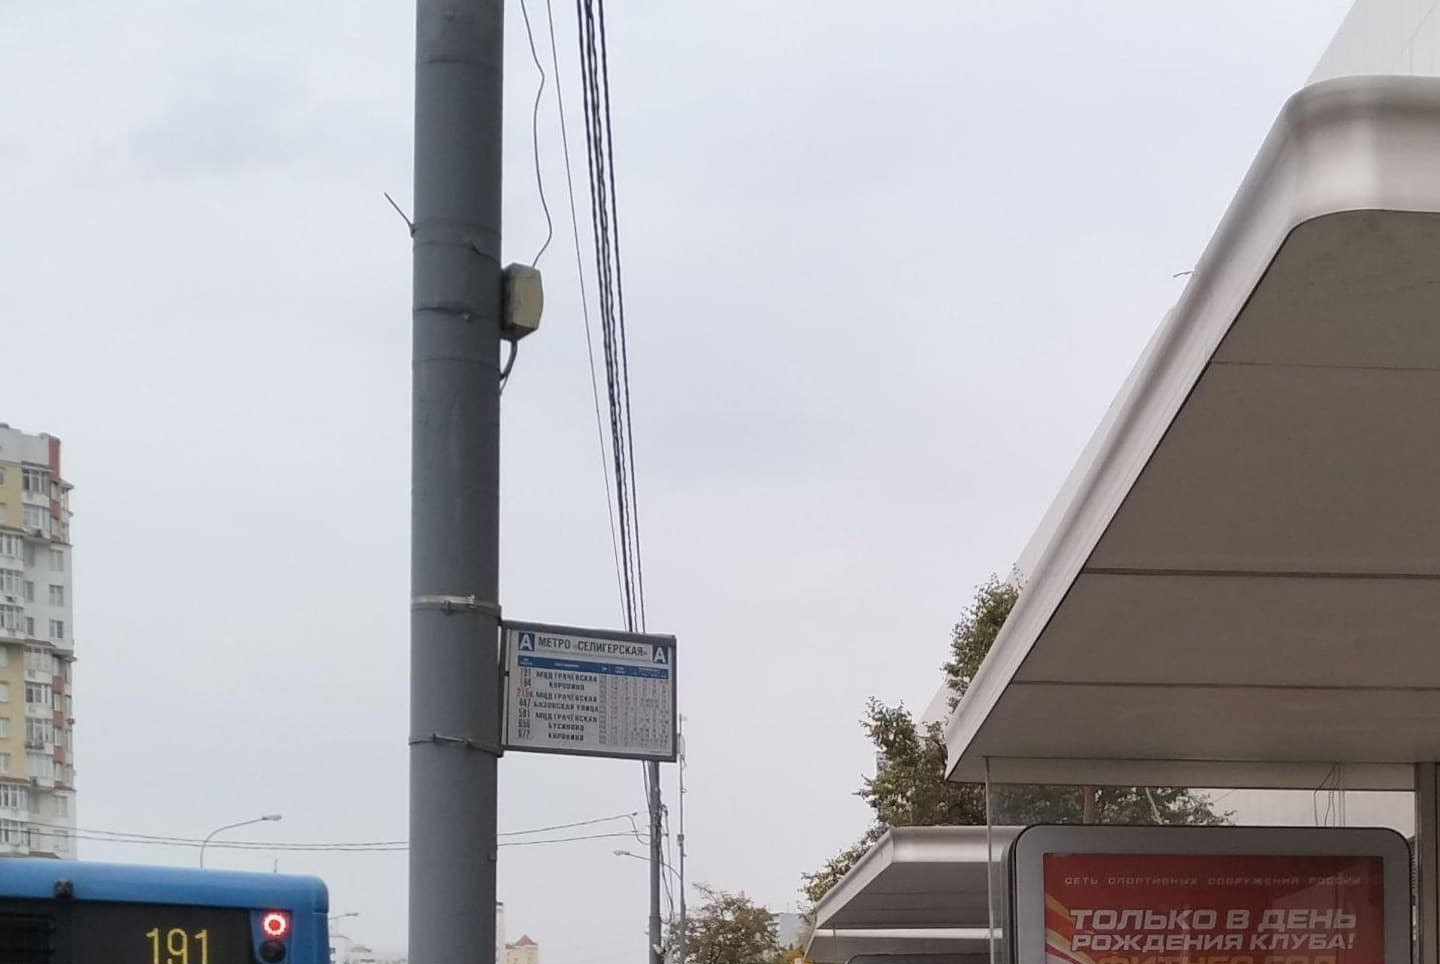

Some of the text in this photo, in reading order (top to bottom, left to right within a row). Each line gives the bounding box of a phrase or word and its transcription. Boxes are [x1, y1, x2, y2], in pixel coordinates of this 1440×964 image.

[519, 634, 533, 650] А
[538, 637, 571, 649] МЕТРО
[654, 647, 666, 663] А
[1070, 908, 1357, 933] ТОЛЬКО В ДЕНЬ
[1071, 933, 1356, 953] РОЖДЕНИЯ КЛУБА!
